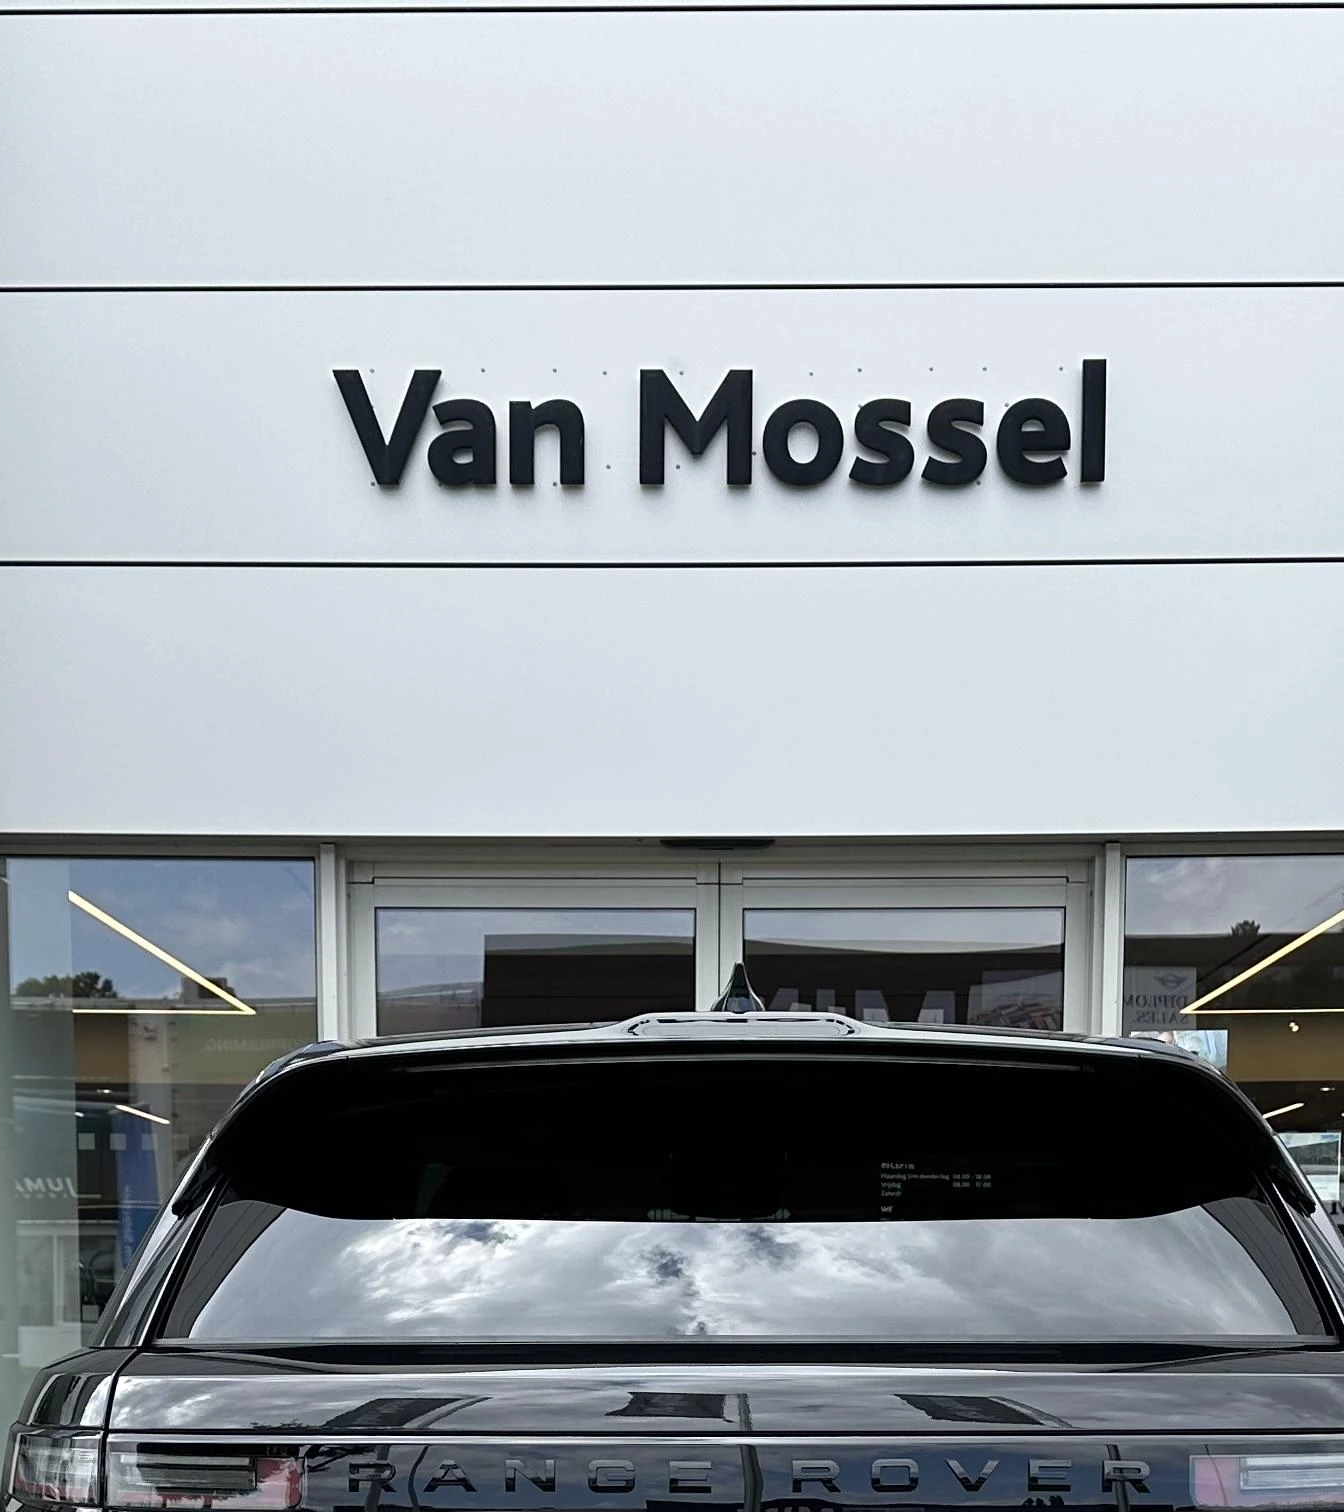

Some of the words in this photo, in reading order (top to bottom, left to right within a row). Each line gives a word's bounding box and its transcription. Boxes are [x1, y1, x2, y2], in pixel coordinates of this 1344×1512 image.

[331, 369, 586, 487] Van
[639, 358, 1108, 488] Mossel
[348, 1458, 713, 1494] RANGE
[791, 1458, 1152, 1494] ROVER
